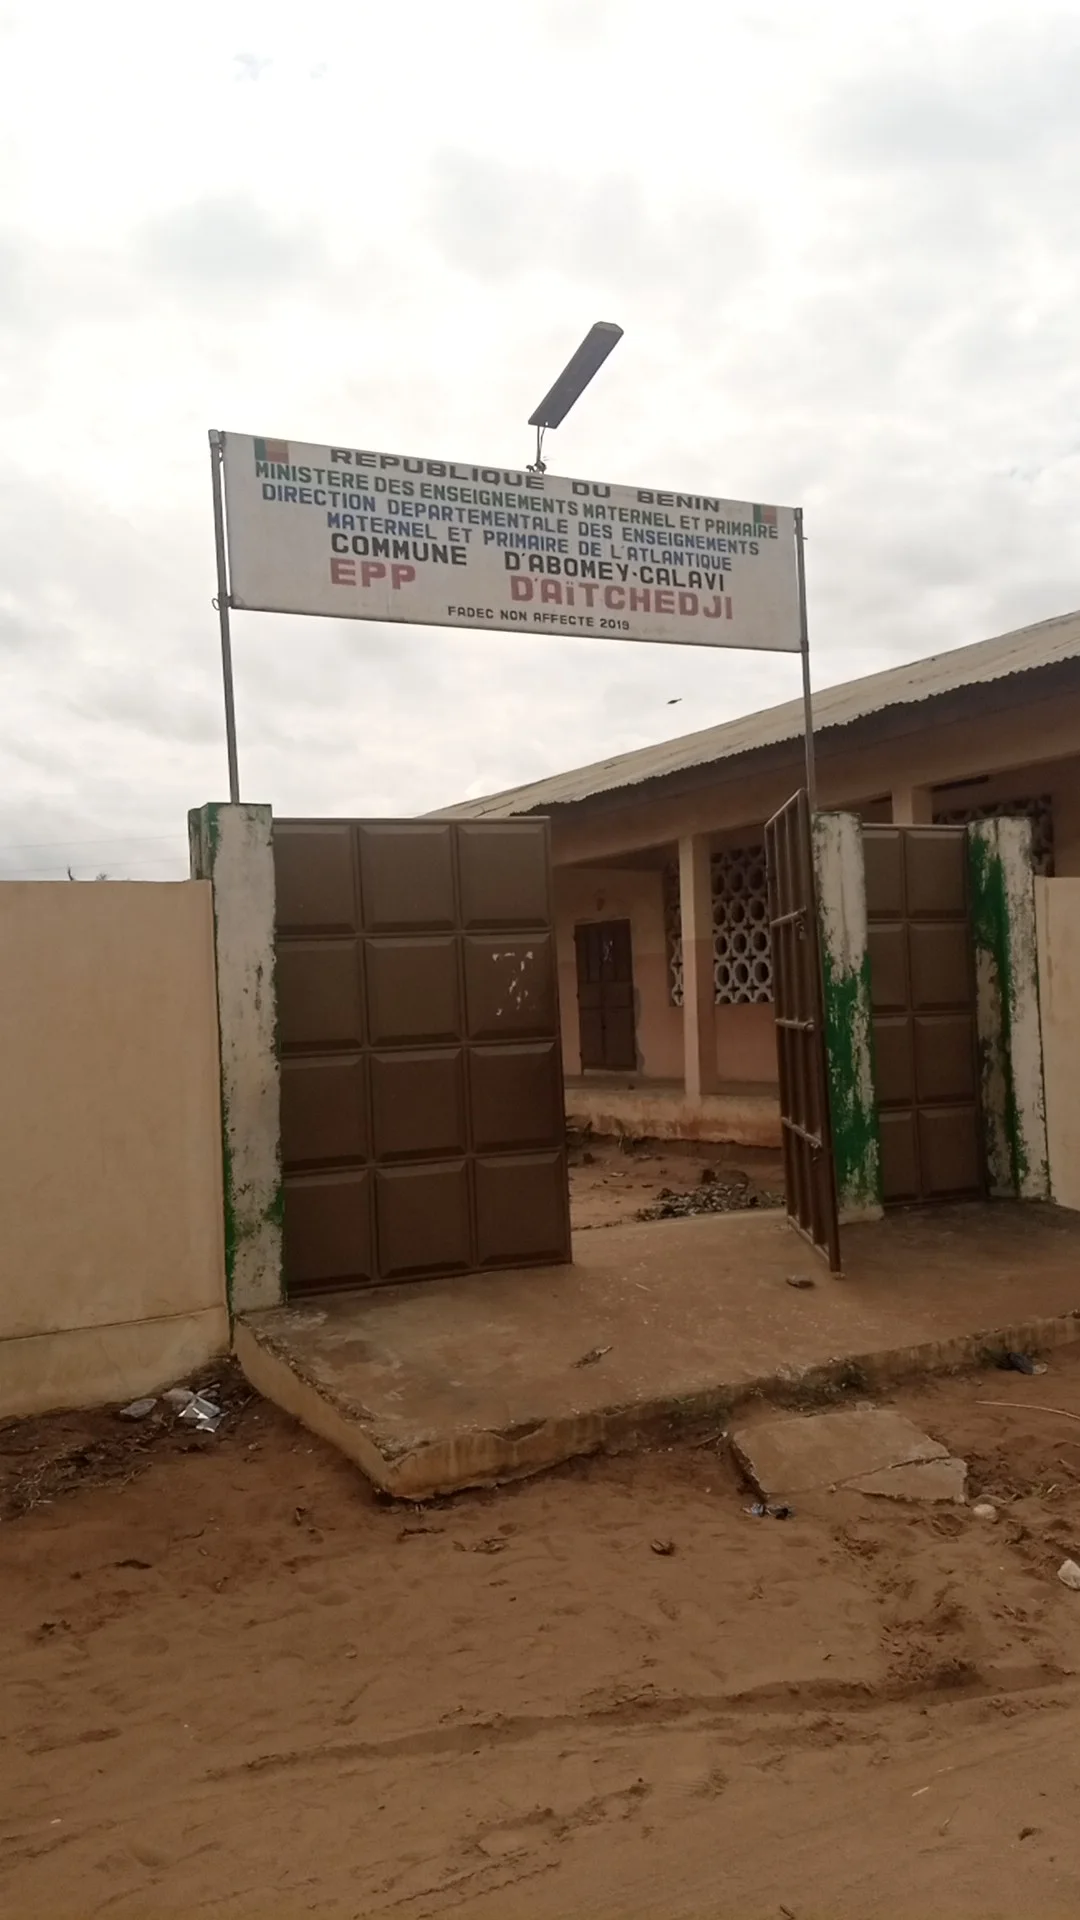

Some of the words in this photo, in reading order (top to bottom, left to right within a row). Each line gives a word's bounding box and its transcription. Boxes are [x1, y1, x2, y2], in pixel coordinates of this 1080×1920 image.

[255, 461, 369, 491] MINISTERE
[374, 476, 414, 496] DES
[420, 482, 578, 516] ENSEIGNEMENTS
[584, 503, 675, 528] MATERNEL
[680, 515, 700, 530] ET
[705, 519, 778, 539] PRIMAIRE
[330, 449, 545, 490] REPUBLIQUE
[572, 482, 611, 498] DU
[637, 490, 720, 513] BENIN
[262, 483, 376, 512] DIRECTION
[388, 499, 568, 534] DEPARTEMENTALE
[578, 521, 612, 539] DES
[622, 527, 759, 556] ENSEIGNEMENTS
[327, 511, 437, 540] MATERNEL
[448, 527, 472, 544] ET
[484, 530, 569, 554] PRIMAIRE
[578, 541, 602, 557] DE
[611, 544, 732, 571] L'ATLANTIQUE
[331, 533, 467, 566] COMMUNE
[330, 557, 416, 590] EPP
[448, 606, 494, 619] FADEC
[500, 610, 528, 622] NON
[533, 612, 594, 627] AFFECTE
[599, 618, 630, 630] 2019
